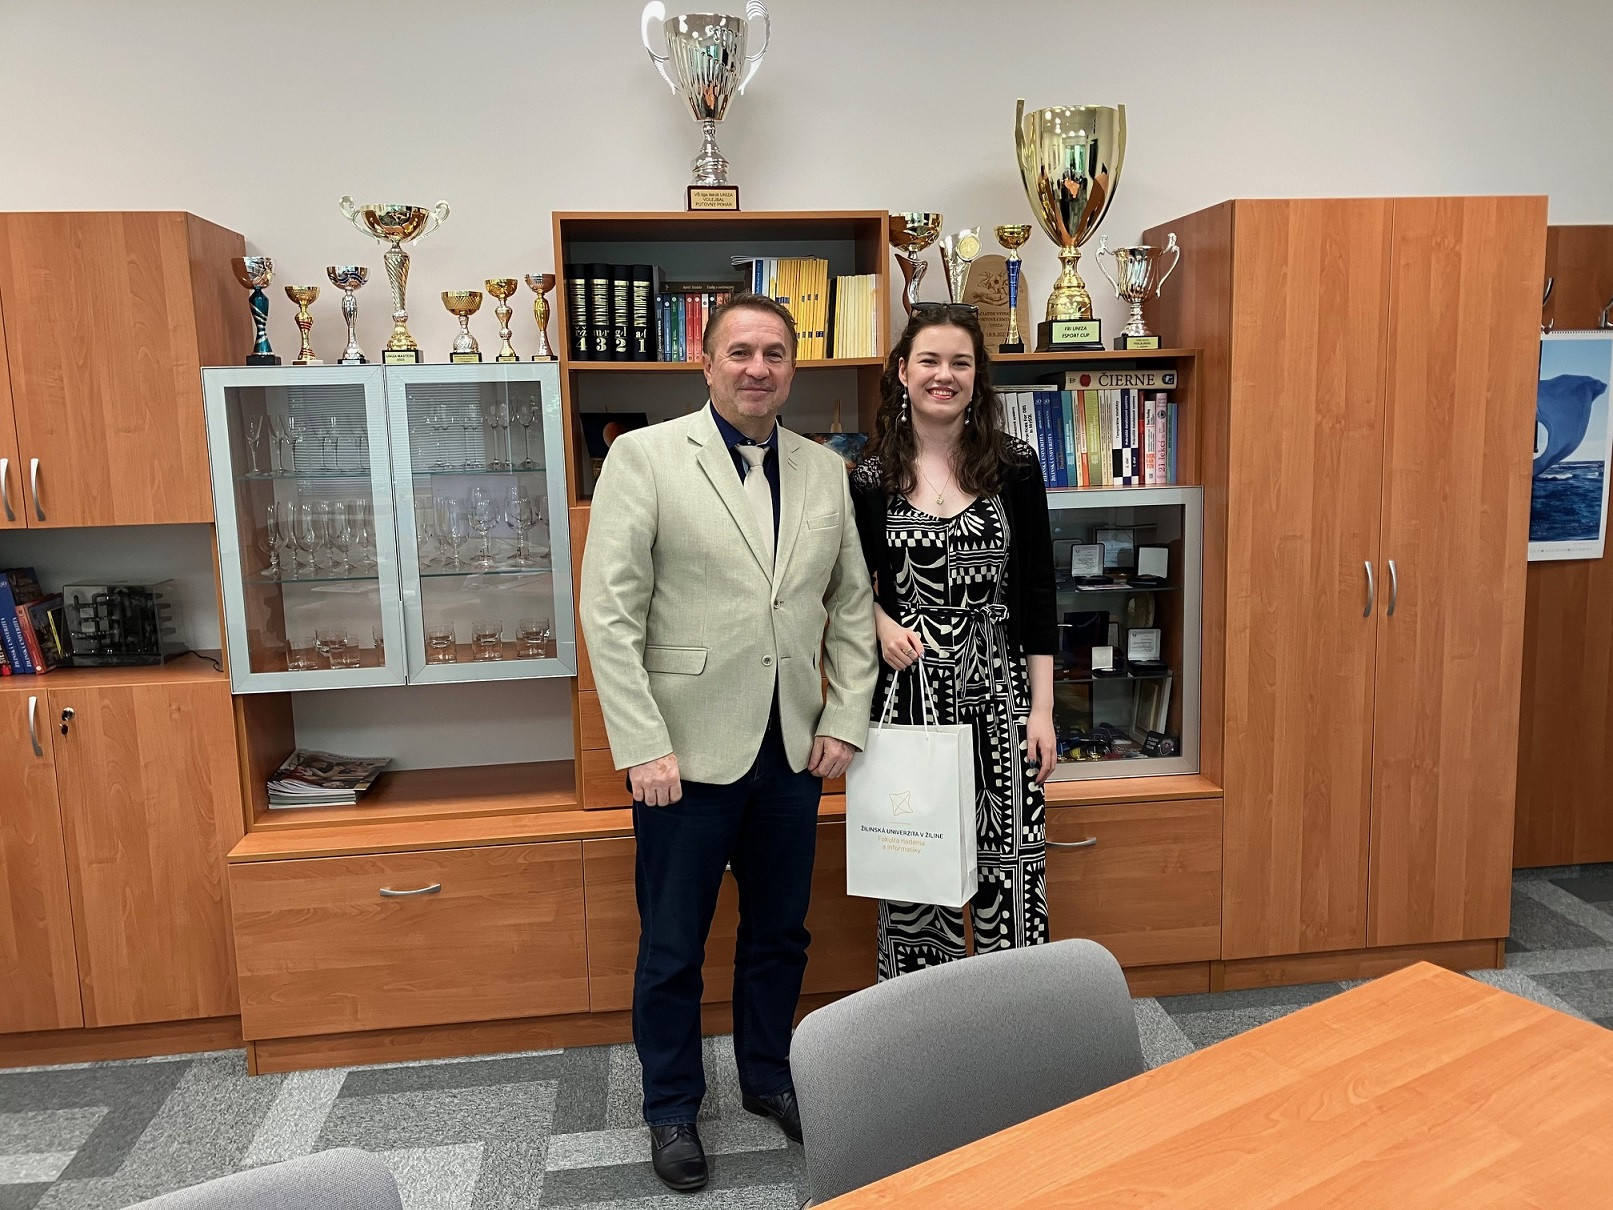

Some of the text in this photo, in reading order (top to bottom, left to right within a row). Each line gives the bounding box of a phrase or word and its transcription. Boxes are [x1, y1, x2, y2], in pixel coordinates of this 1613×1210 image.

[576, 337, 587, 351] 4
[596, 337, 607, 351] 3
[615, 338, 626, 352] 2
[638, 338, 646, 352] 1
[1099, 372, 1155, 386] ČIERNE
[1158, 463, 1165, 472] 21
[860, 825, 886, 834] ŽILINSKÁ
[886, 828, 919, 837] UNIVERZITA
[925, 831, 943, 839] ŽILINE
[877, 836, 900, 844] Fakulta
[887, 844, 921, 854] informatiky
